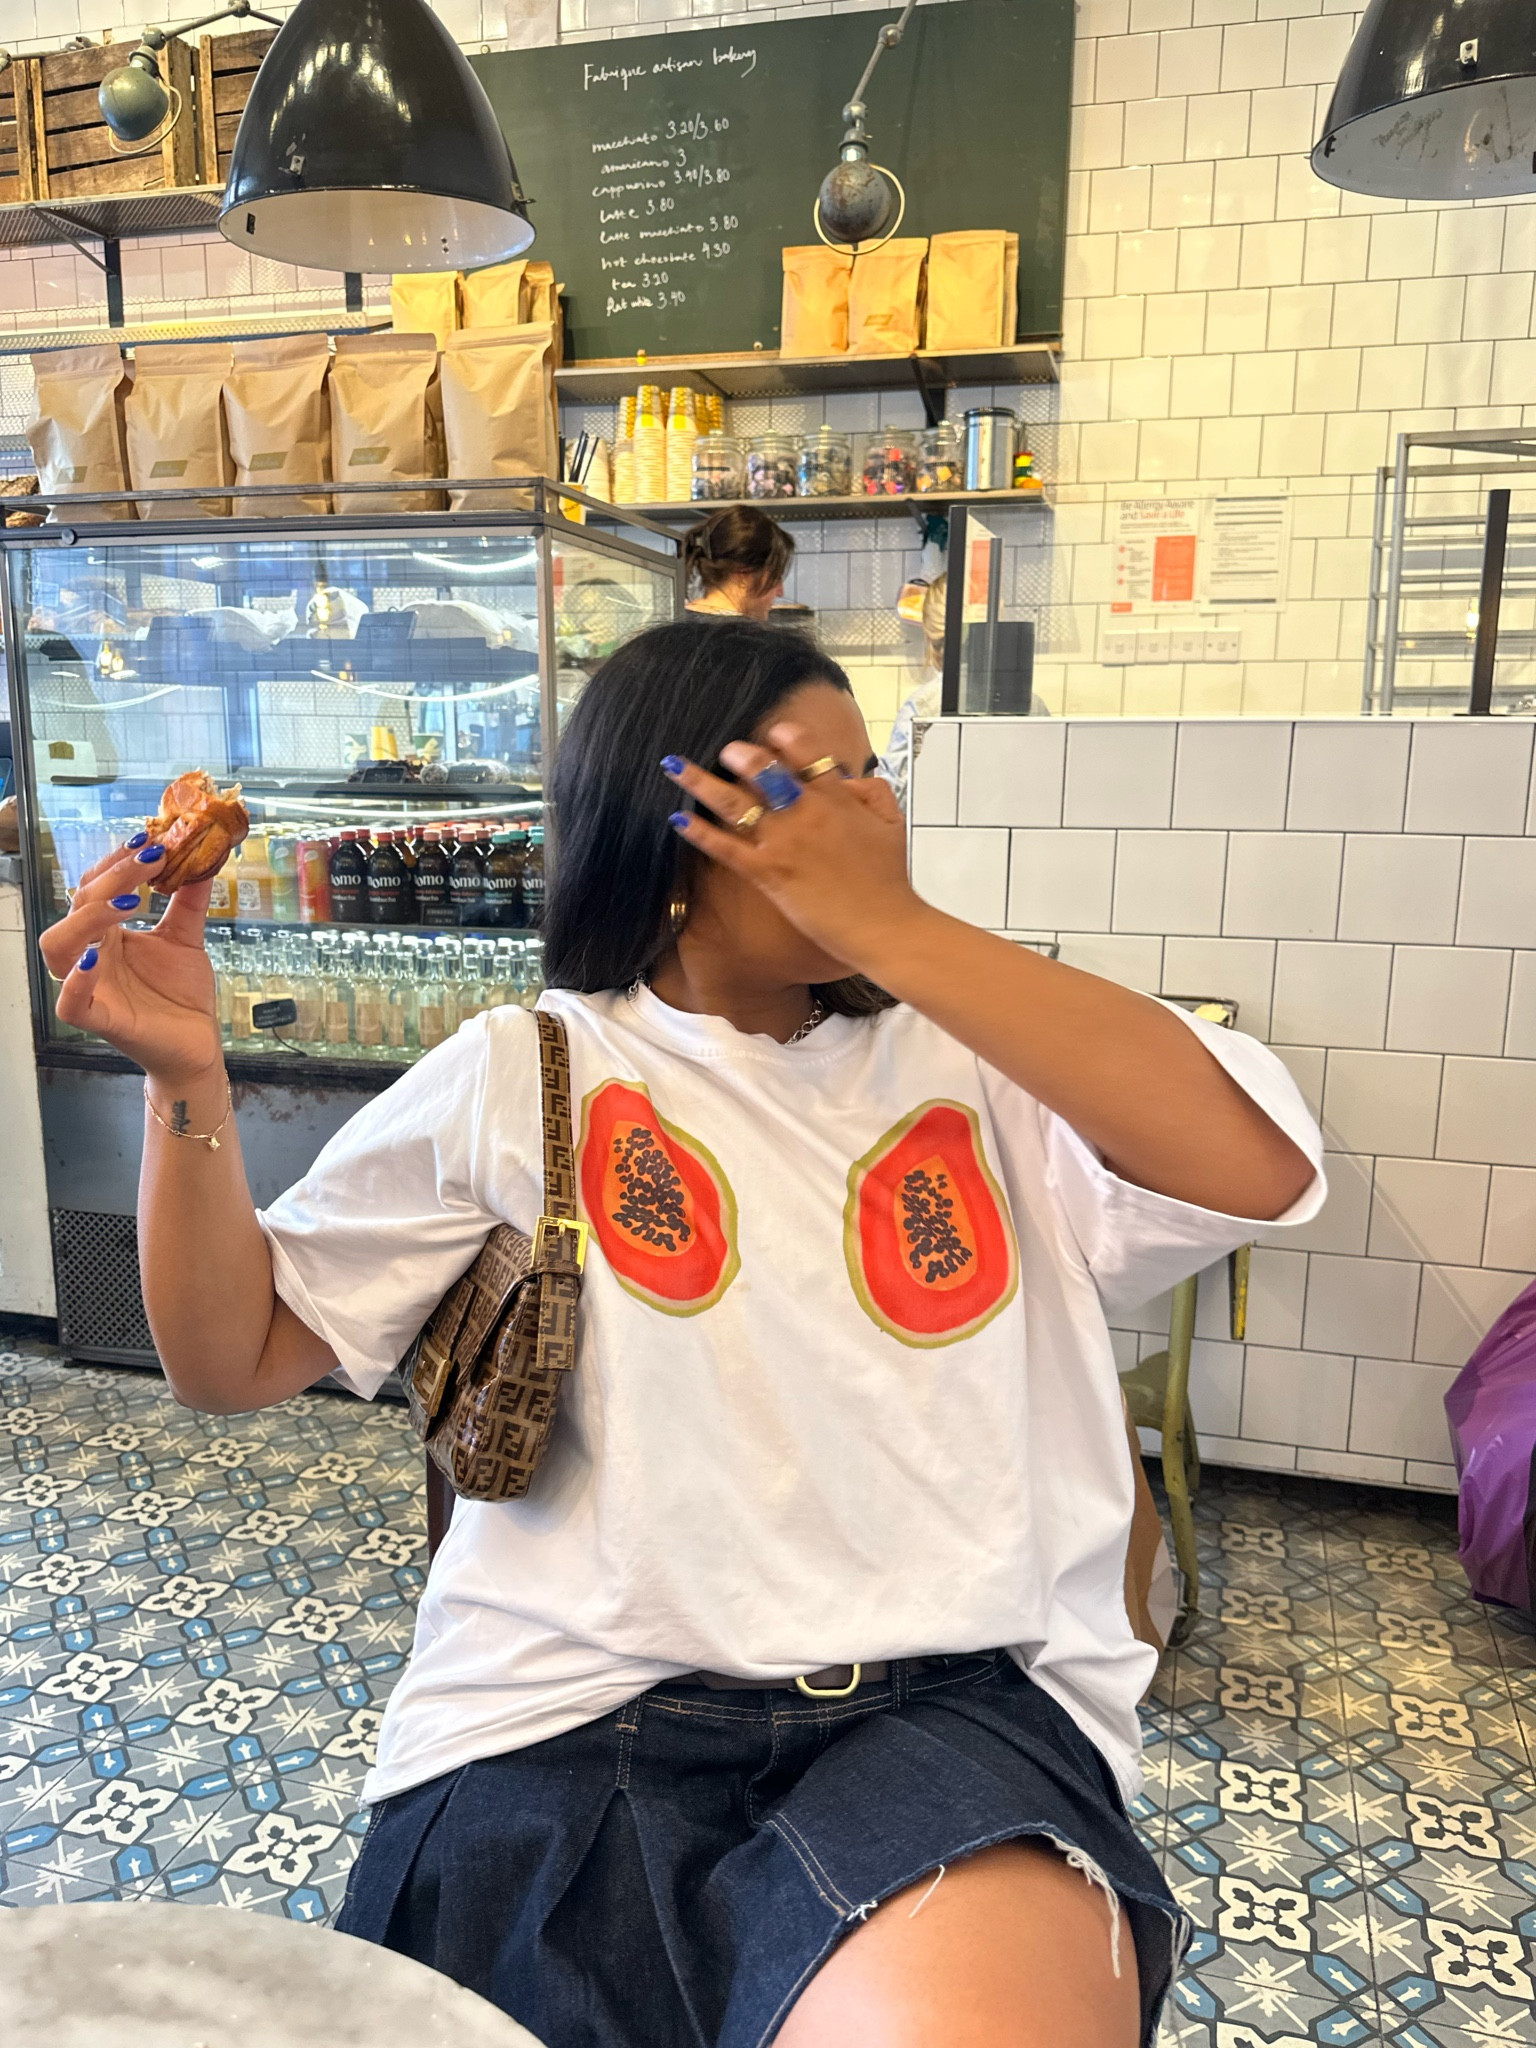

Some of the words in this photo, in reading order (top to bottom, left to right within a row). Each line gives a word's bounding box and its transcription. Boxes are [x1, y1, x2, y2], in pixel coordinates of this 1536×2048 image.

[583, 63, 647, 92] Fabrique
[652, 57, 704, 73] artisan
[713, 46, 757, 78] bakery
[600, 159, 670, 175] americano
[676, 148, 687, 168] 3
[645, 197, 675, 216] 3.80
[709, 215, 739, 232] 3.80
[601, 256, 628, 271] hot
[634, 252, 696, 266] chocolate
[611, 278, 637, 291] tea
[606, 296, 628, 317] flat
[656, 290, 686, 310] 3.40
